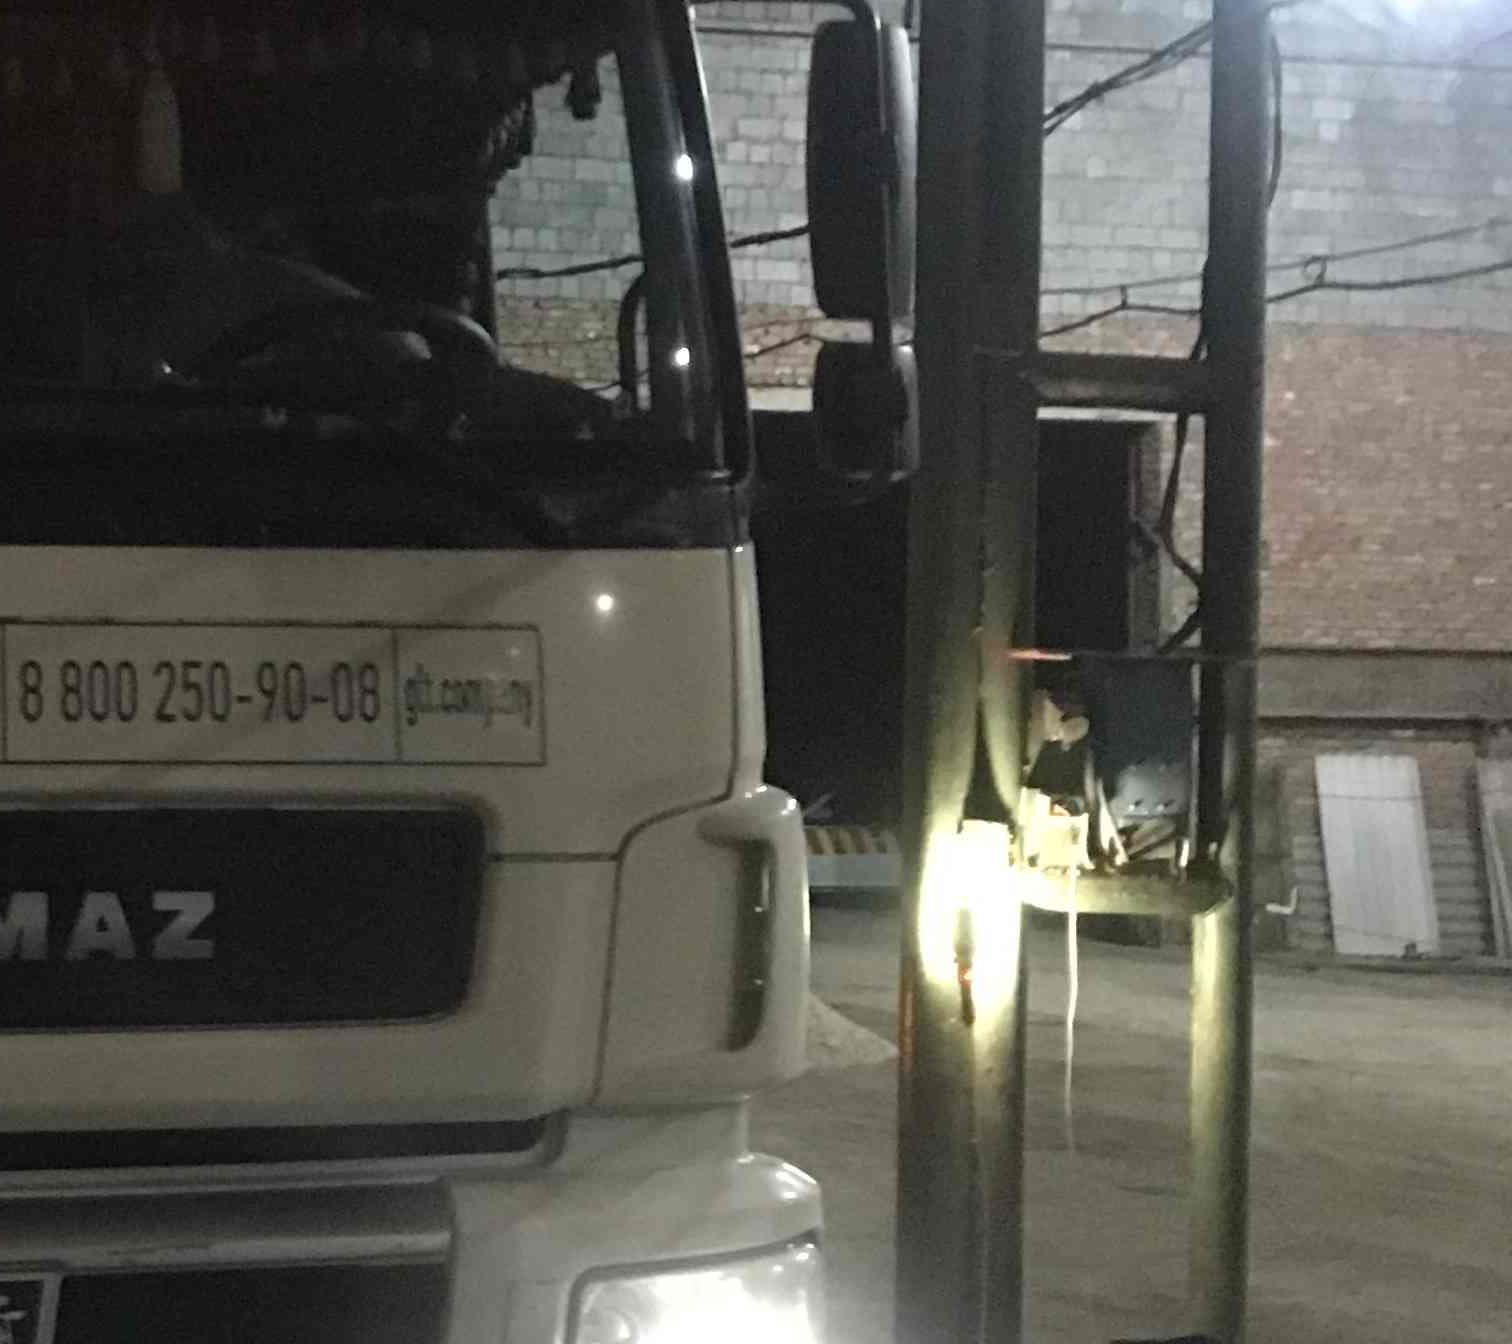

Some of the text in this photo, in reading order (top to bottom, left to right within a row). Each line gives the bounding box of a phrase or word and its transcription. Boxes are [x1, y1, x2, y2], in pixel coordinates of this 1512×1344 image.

[18, 659, 381, 724] 8 800 250-90-08
